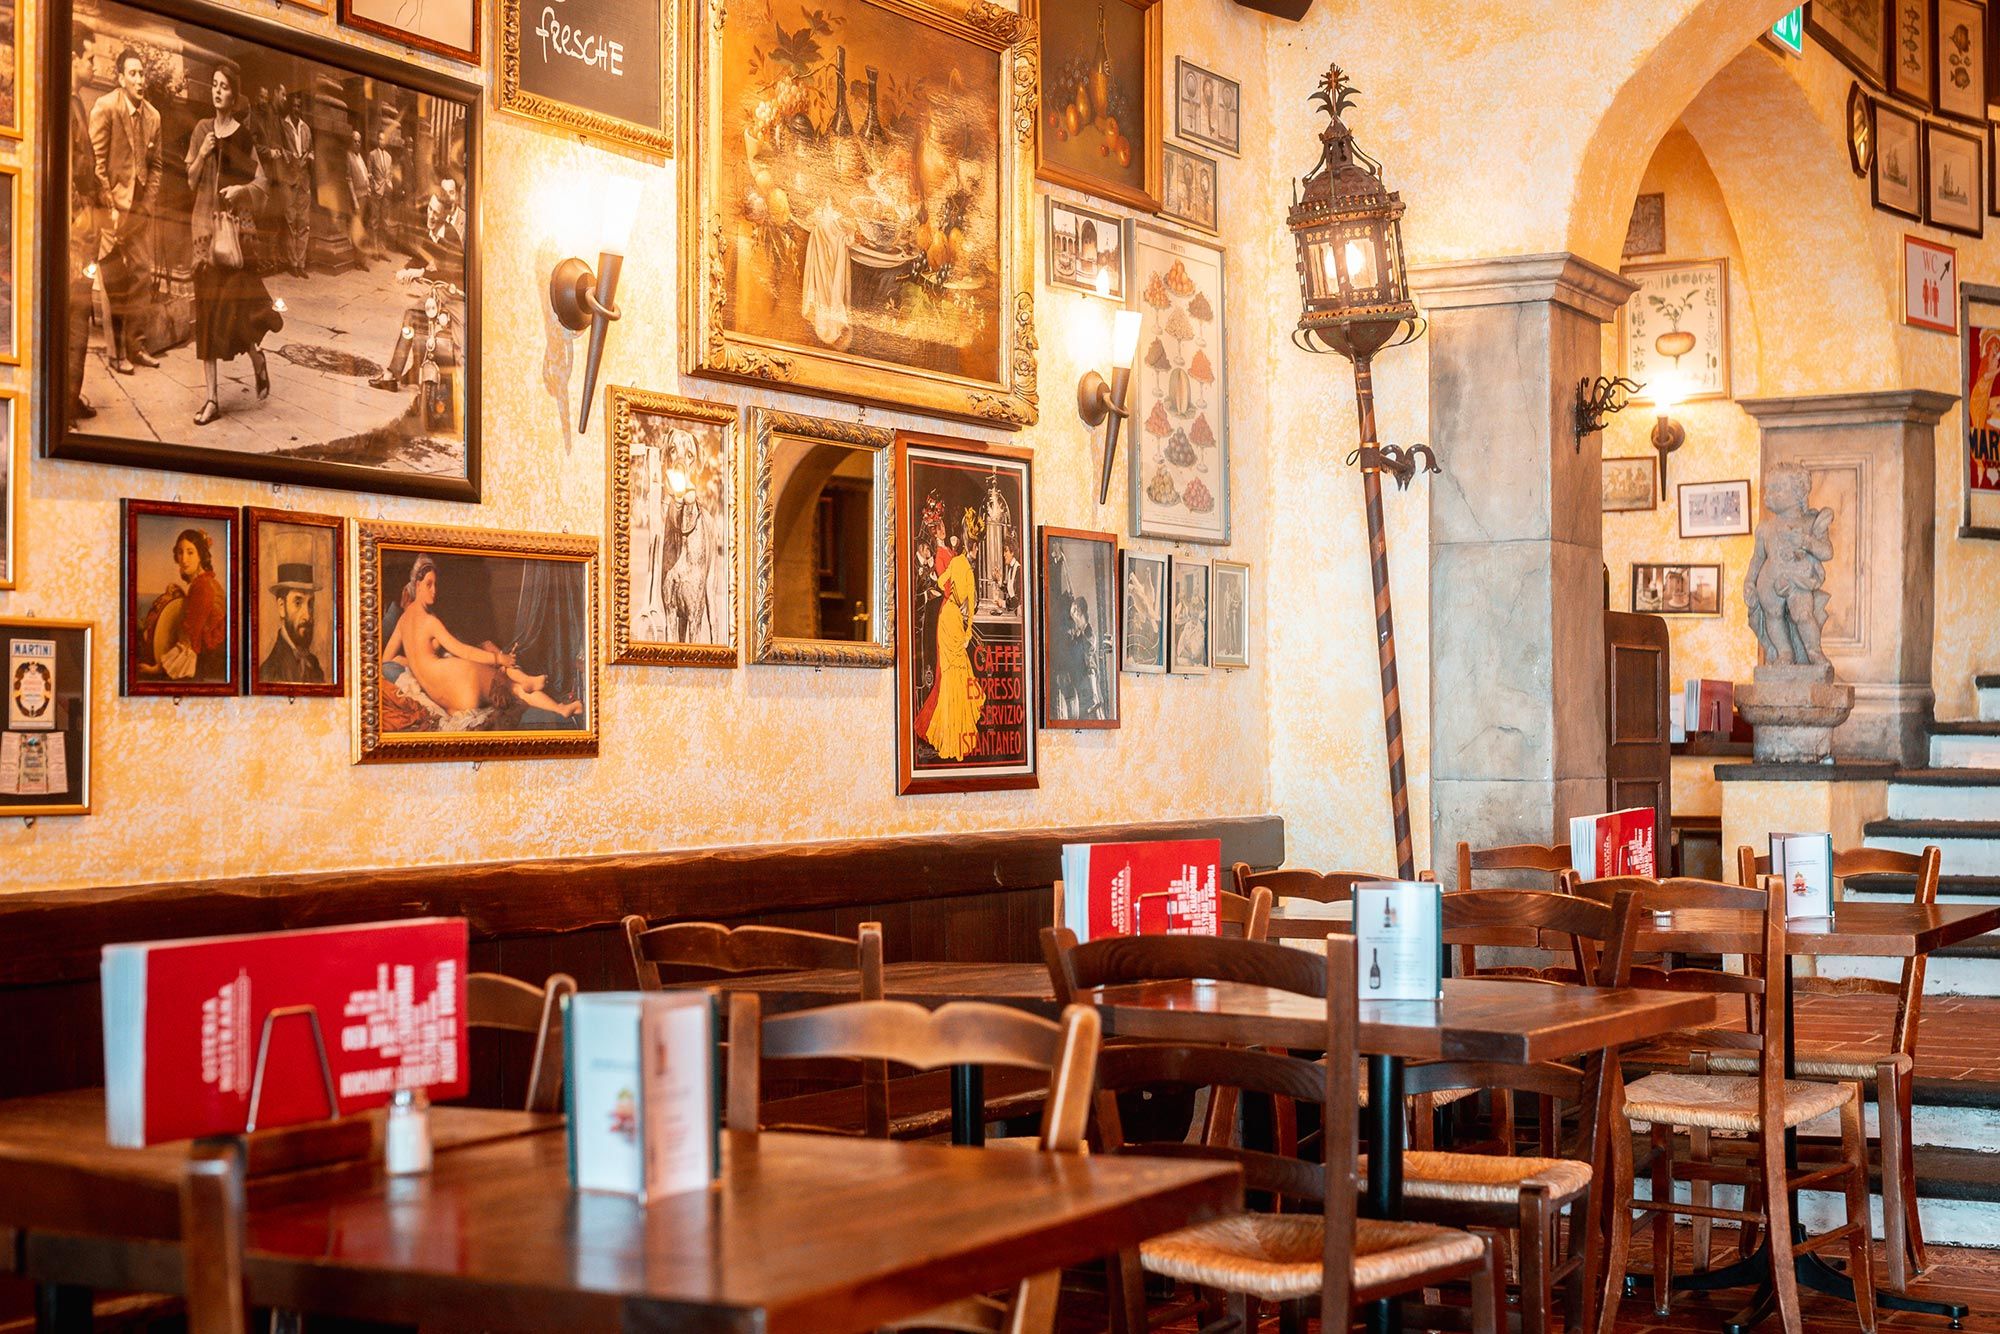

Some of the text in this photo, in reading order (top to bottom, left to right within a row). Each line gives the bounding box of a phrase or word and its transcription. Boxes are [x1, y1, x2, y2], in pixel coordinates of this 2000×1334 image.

[1922, 251, 1938, 273] WC
[14, 643, 52, 656] MARTINI
[966, 677, 1021, 700] ESPRESSO
[980, 704, 1023, 725] SERVIZIO
[959, 730, 1021, 757] ISTANTANEO
